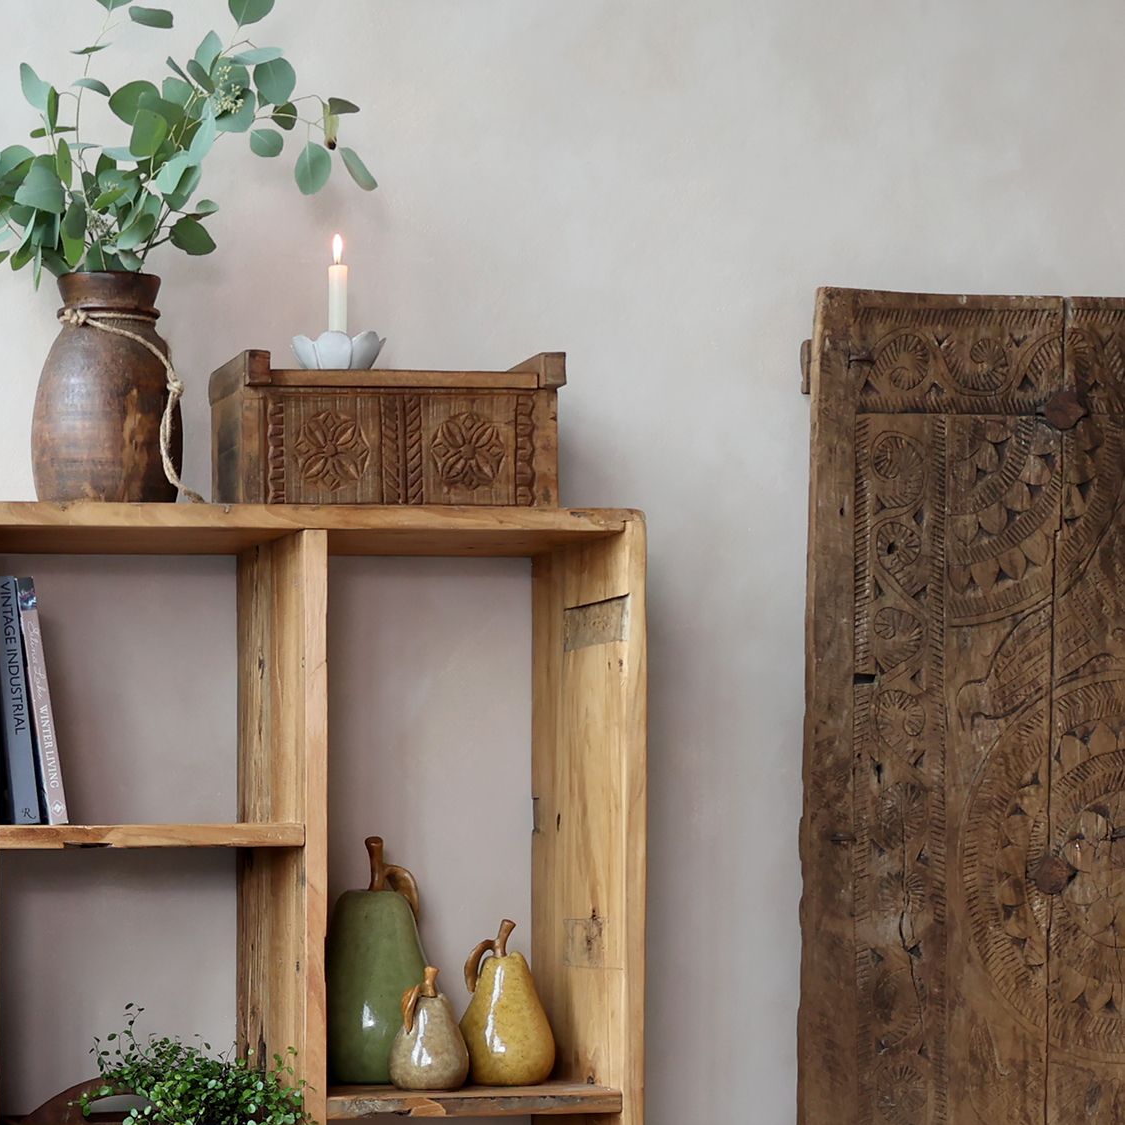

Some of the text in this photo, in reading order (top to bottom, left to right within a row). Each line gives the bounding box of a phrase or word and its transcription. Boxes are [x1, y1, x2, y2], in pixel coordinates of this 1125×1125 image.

[0, 581, 26, 735] VINTAGE INDUSTRIAL
[39, 704, 53, 749] WINTER
[45, 750, 59, 789] LIVING
